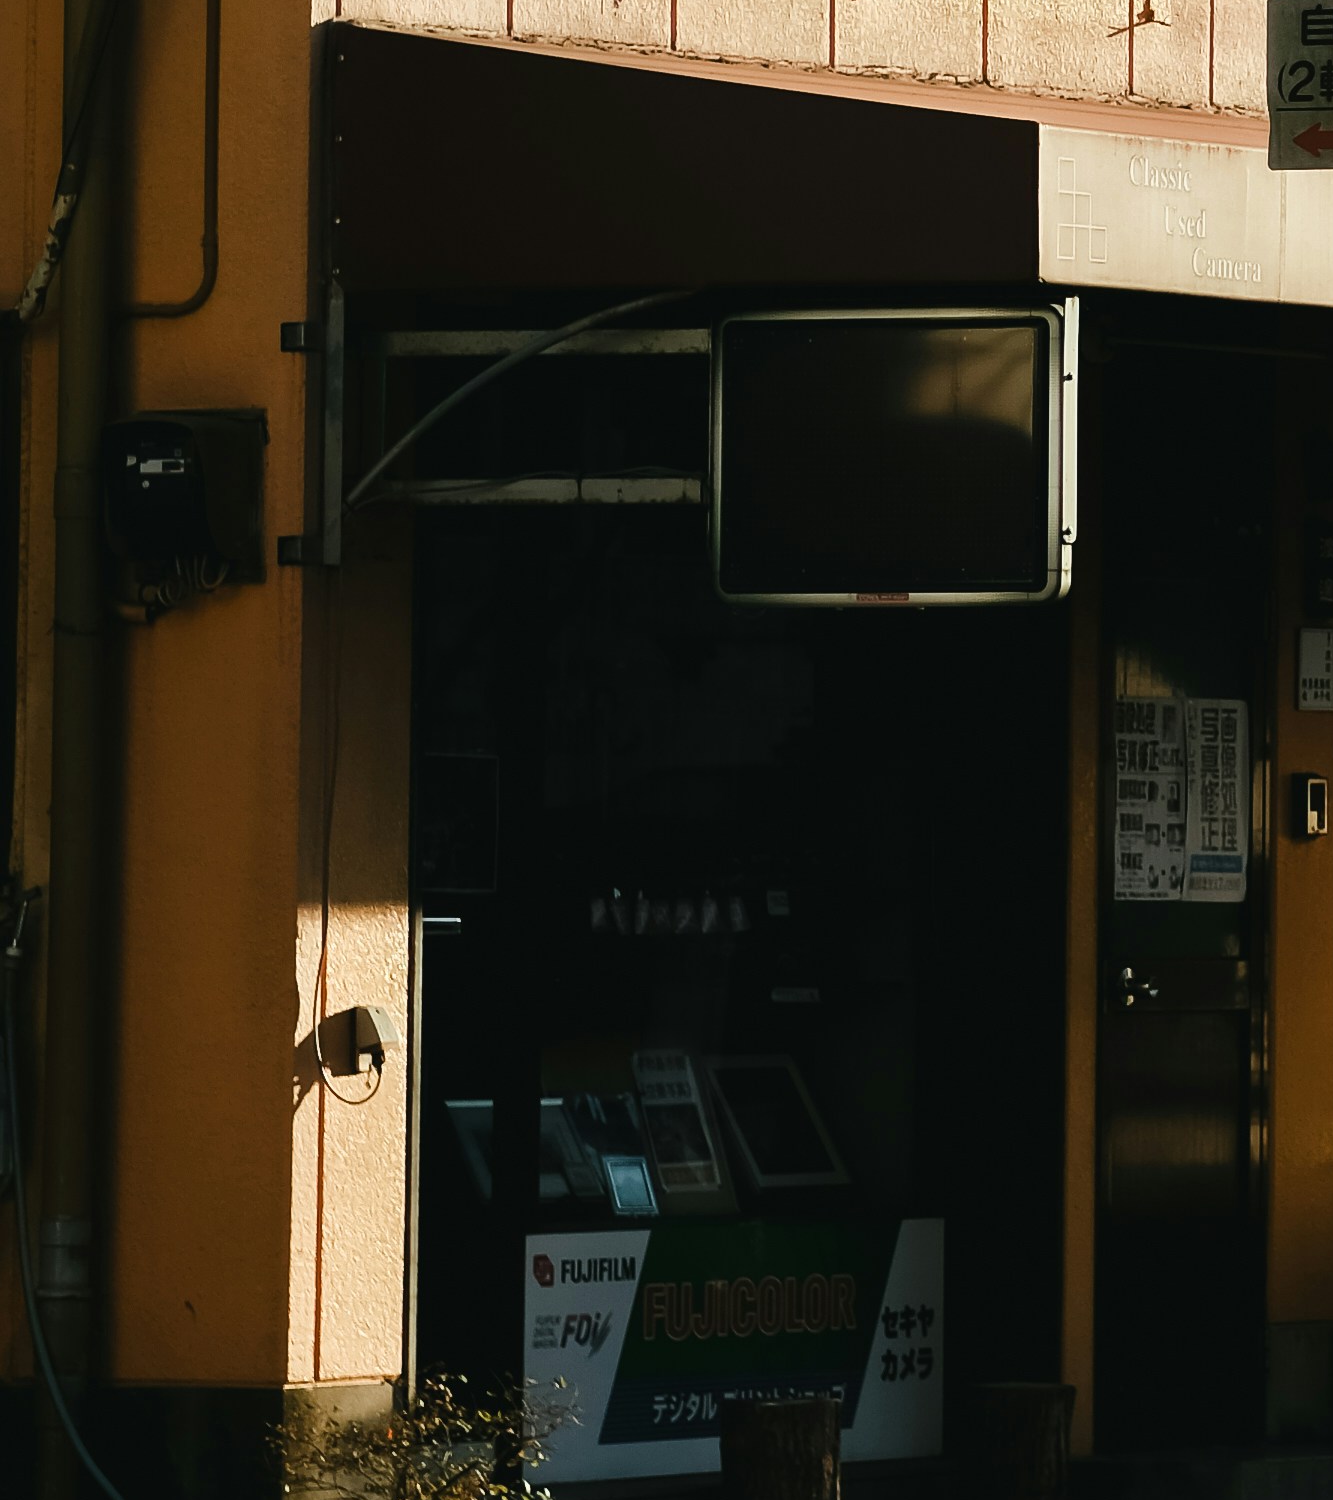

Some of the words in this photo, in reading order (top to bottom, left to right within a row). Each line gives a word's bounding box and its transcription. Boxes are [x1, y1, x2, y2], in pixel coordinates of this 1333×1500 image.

[1128, 152, 1193, 194] Classic
[1163, 205, 1208, 240] Used
[1190, 247, 1263, 285] Camera
[560, 1256, 636, 1285] FUJIFILM
[642, 1273, 857, 1342] FUJICOLOR
[881, 1303, 935, 1340] セキヤ
[880, 1346, 934, 1382] カメラ
[652, 1391, 719, 1425] デジタル
